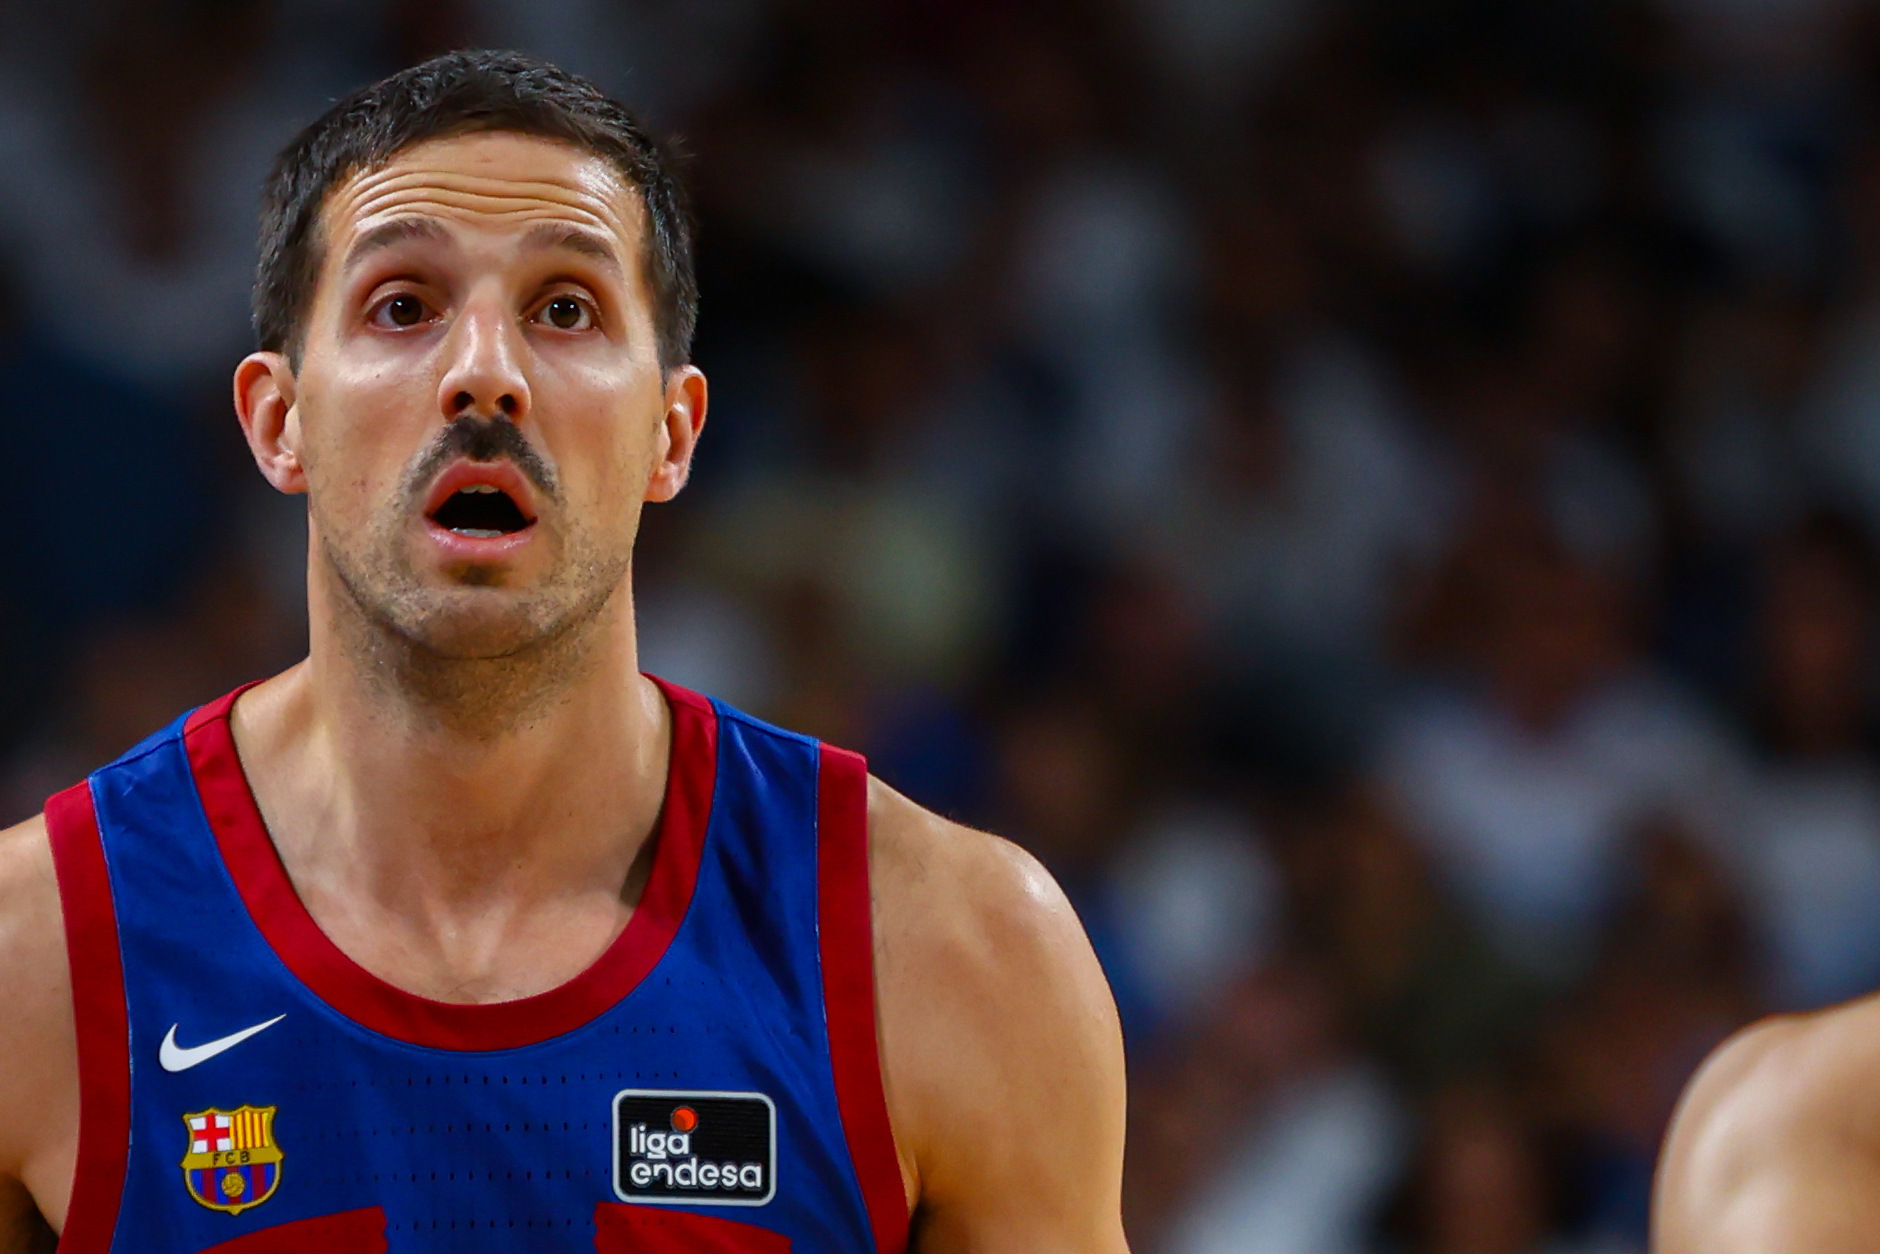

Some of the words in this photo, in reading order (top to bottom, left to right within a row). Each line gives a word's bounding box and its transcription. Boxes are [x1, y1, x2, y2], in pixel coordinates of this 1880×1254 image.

[630, 1123, 690, 1160] liga
[212, 1150, 251, 1166] FCB
[630, 1156, 763, 1188] endesa
